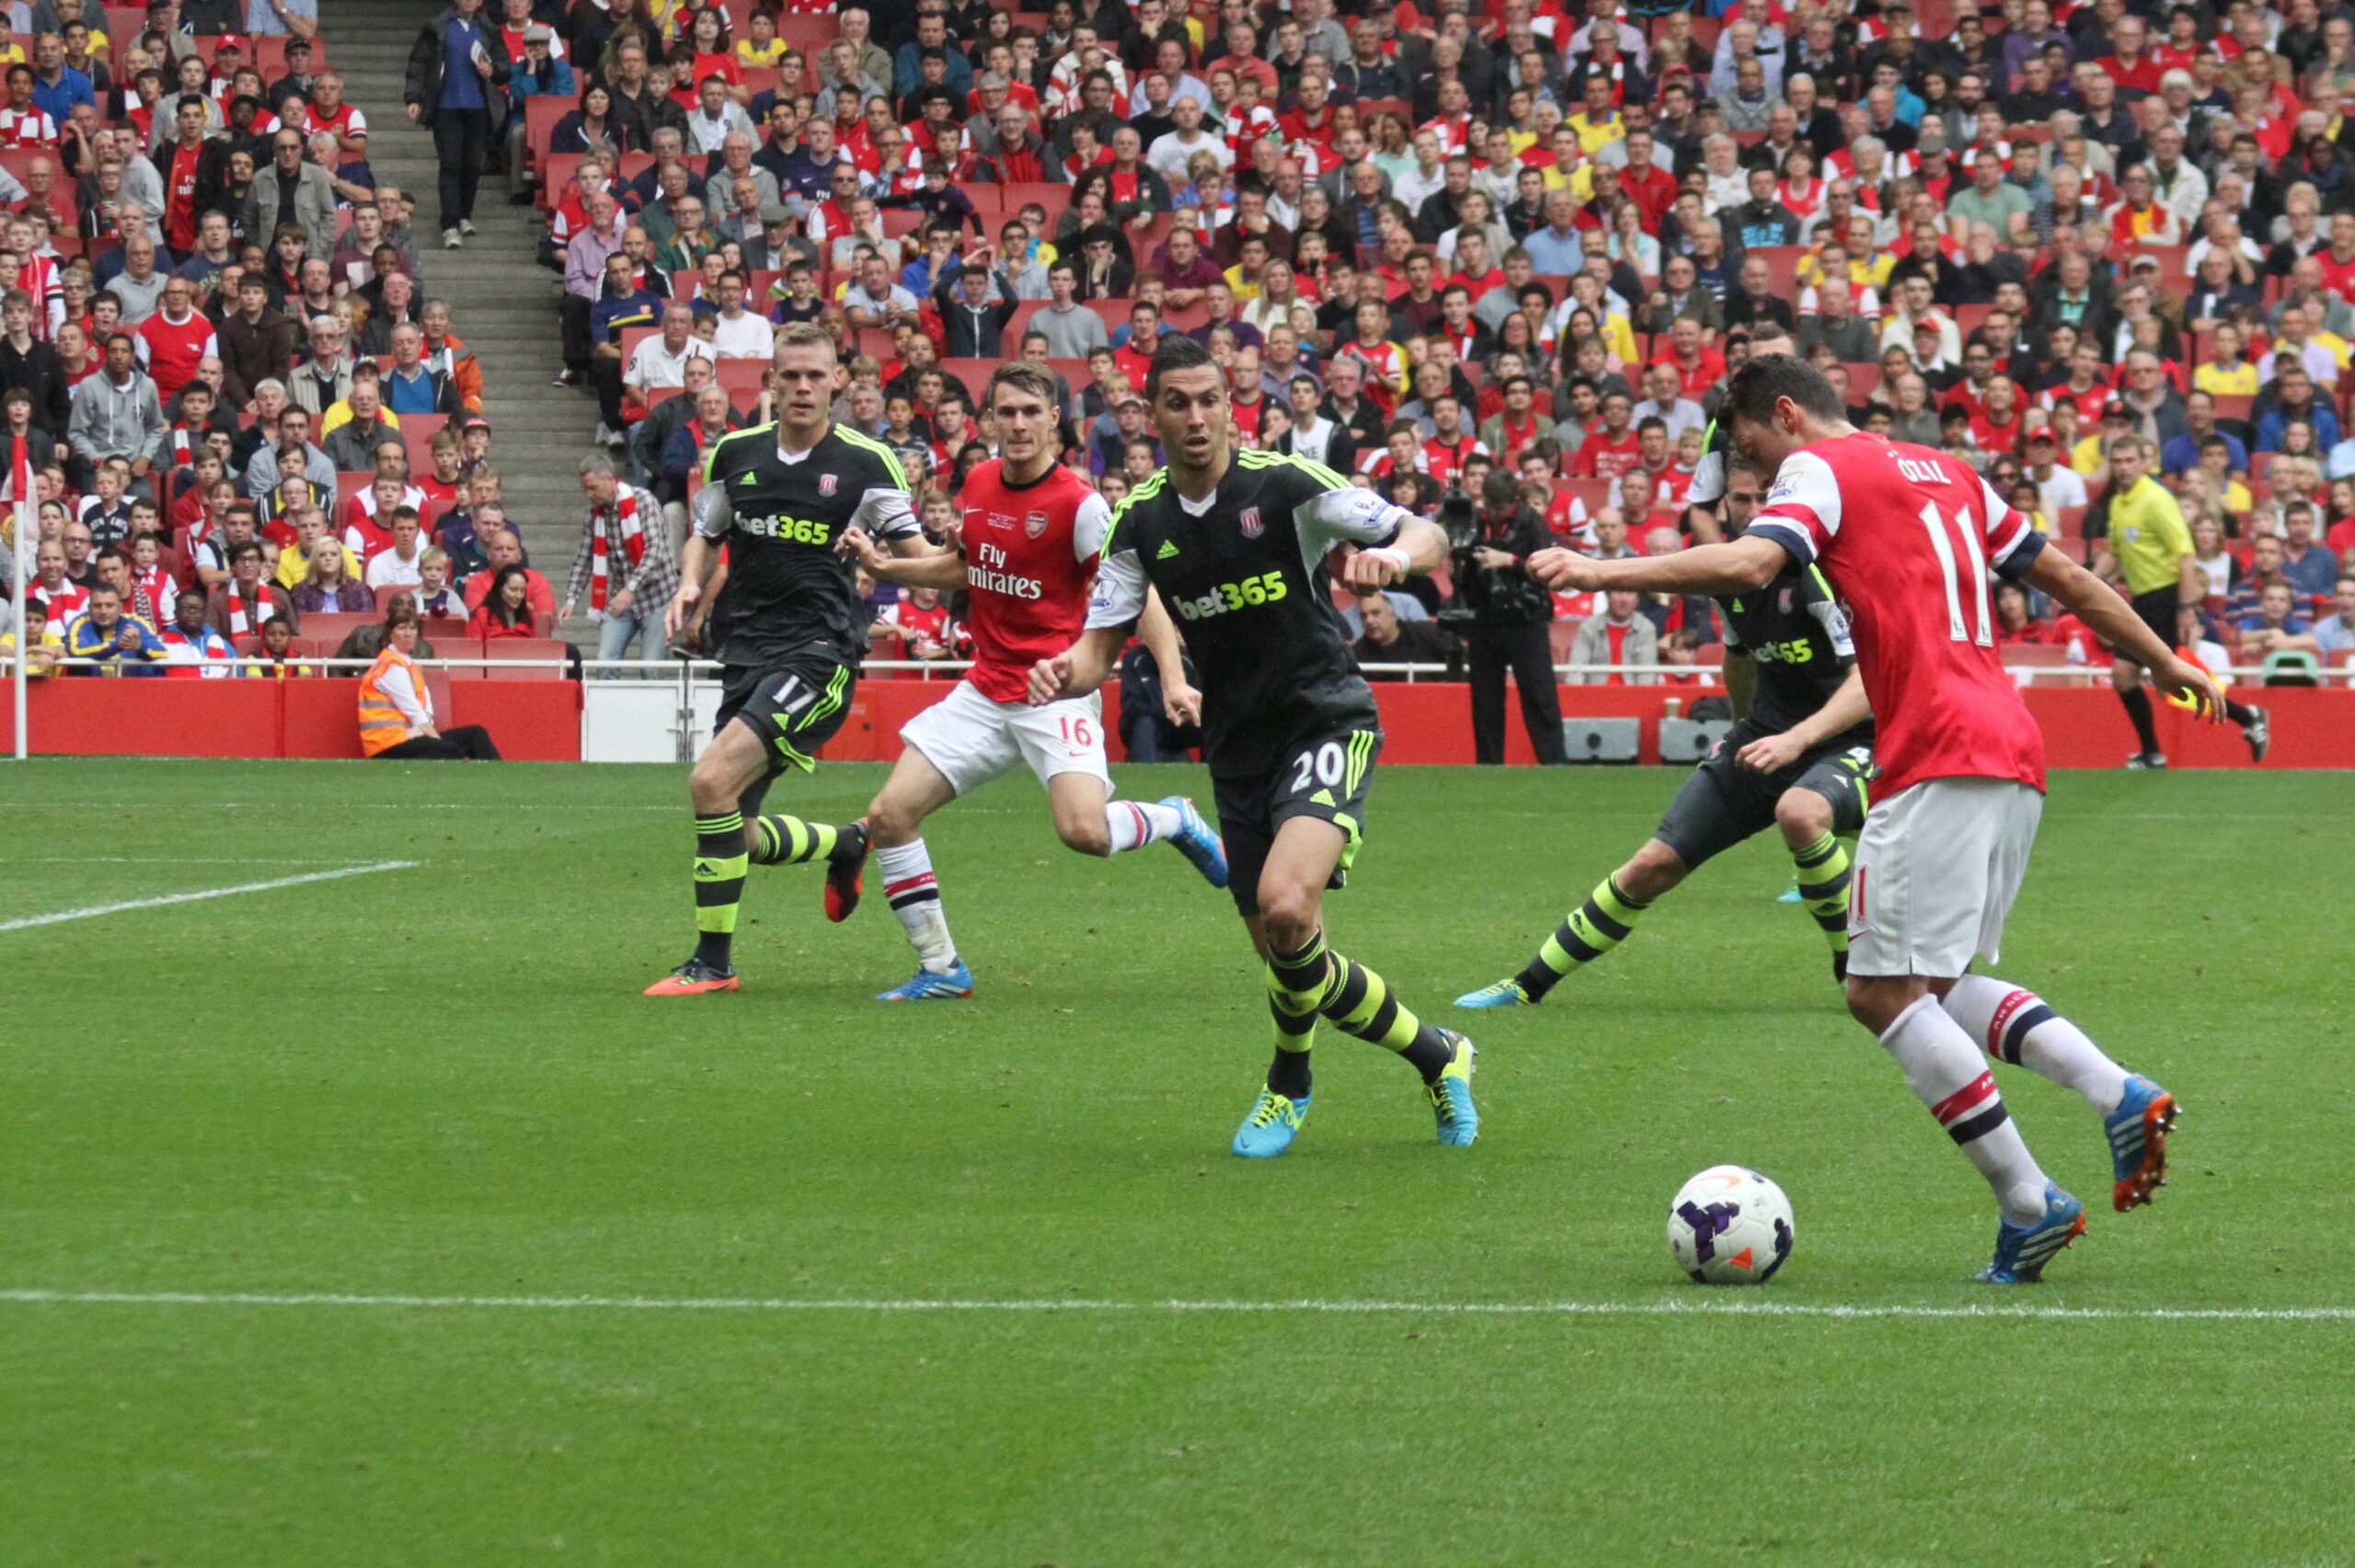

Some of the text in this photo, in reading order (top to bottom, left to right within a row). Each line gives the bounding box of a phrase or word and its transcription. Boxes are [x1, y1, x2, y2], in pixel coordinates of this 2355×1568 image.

[1887, 450, 1952, 485] ÖZIL
[734, 511, 830, 545] bet365
[979, 542, 1007, 568] Fly
[1918, 498, 1993, 647] 11
[968, 564, 1042, 600] mirates
[1172, 570, 1287, 621] bet365
[772, 674, 819, 715] 17
[1060, 716, 1092, 746] 16
[1291, 741, 1345, 795] 20
